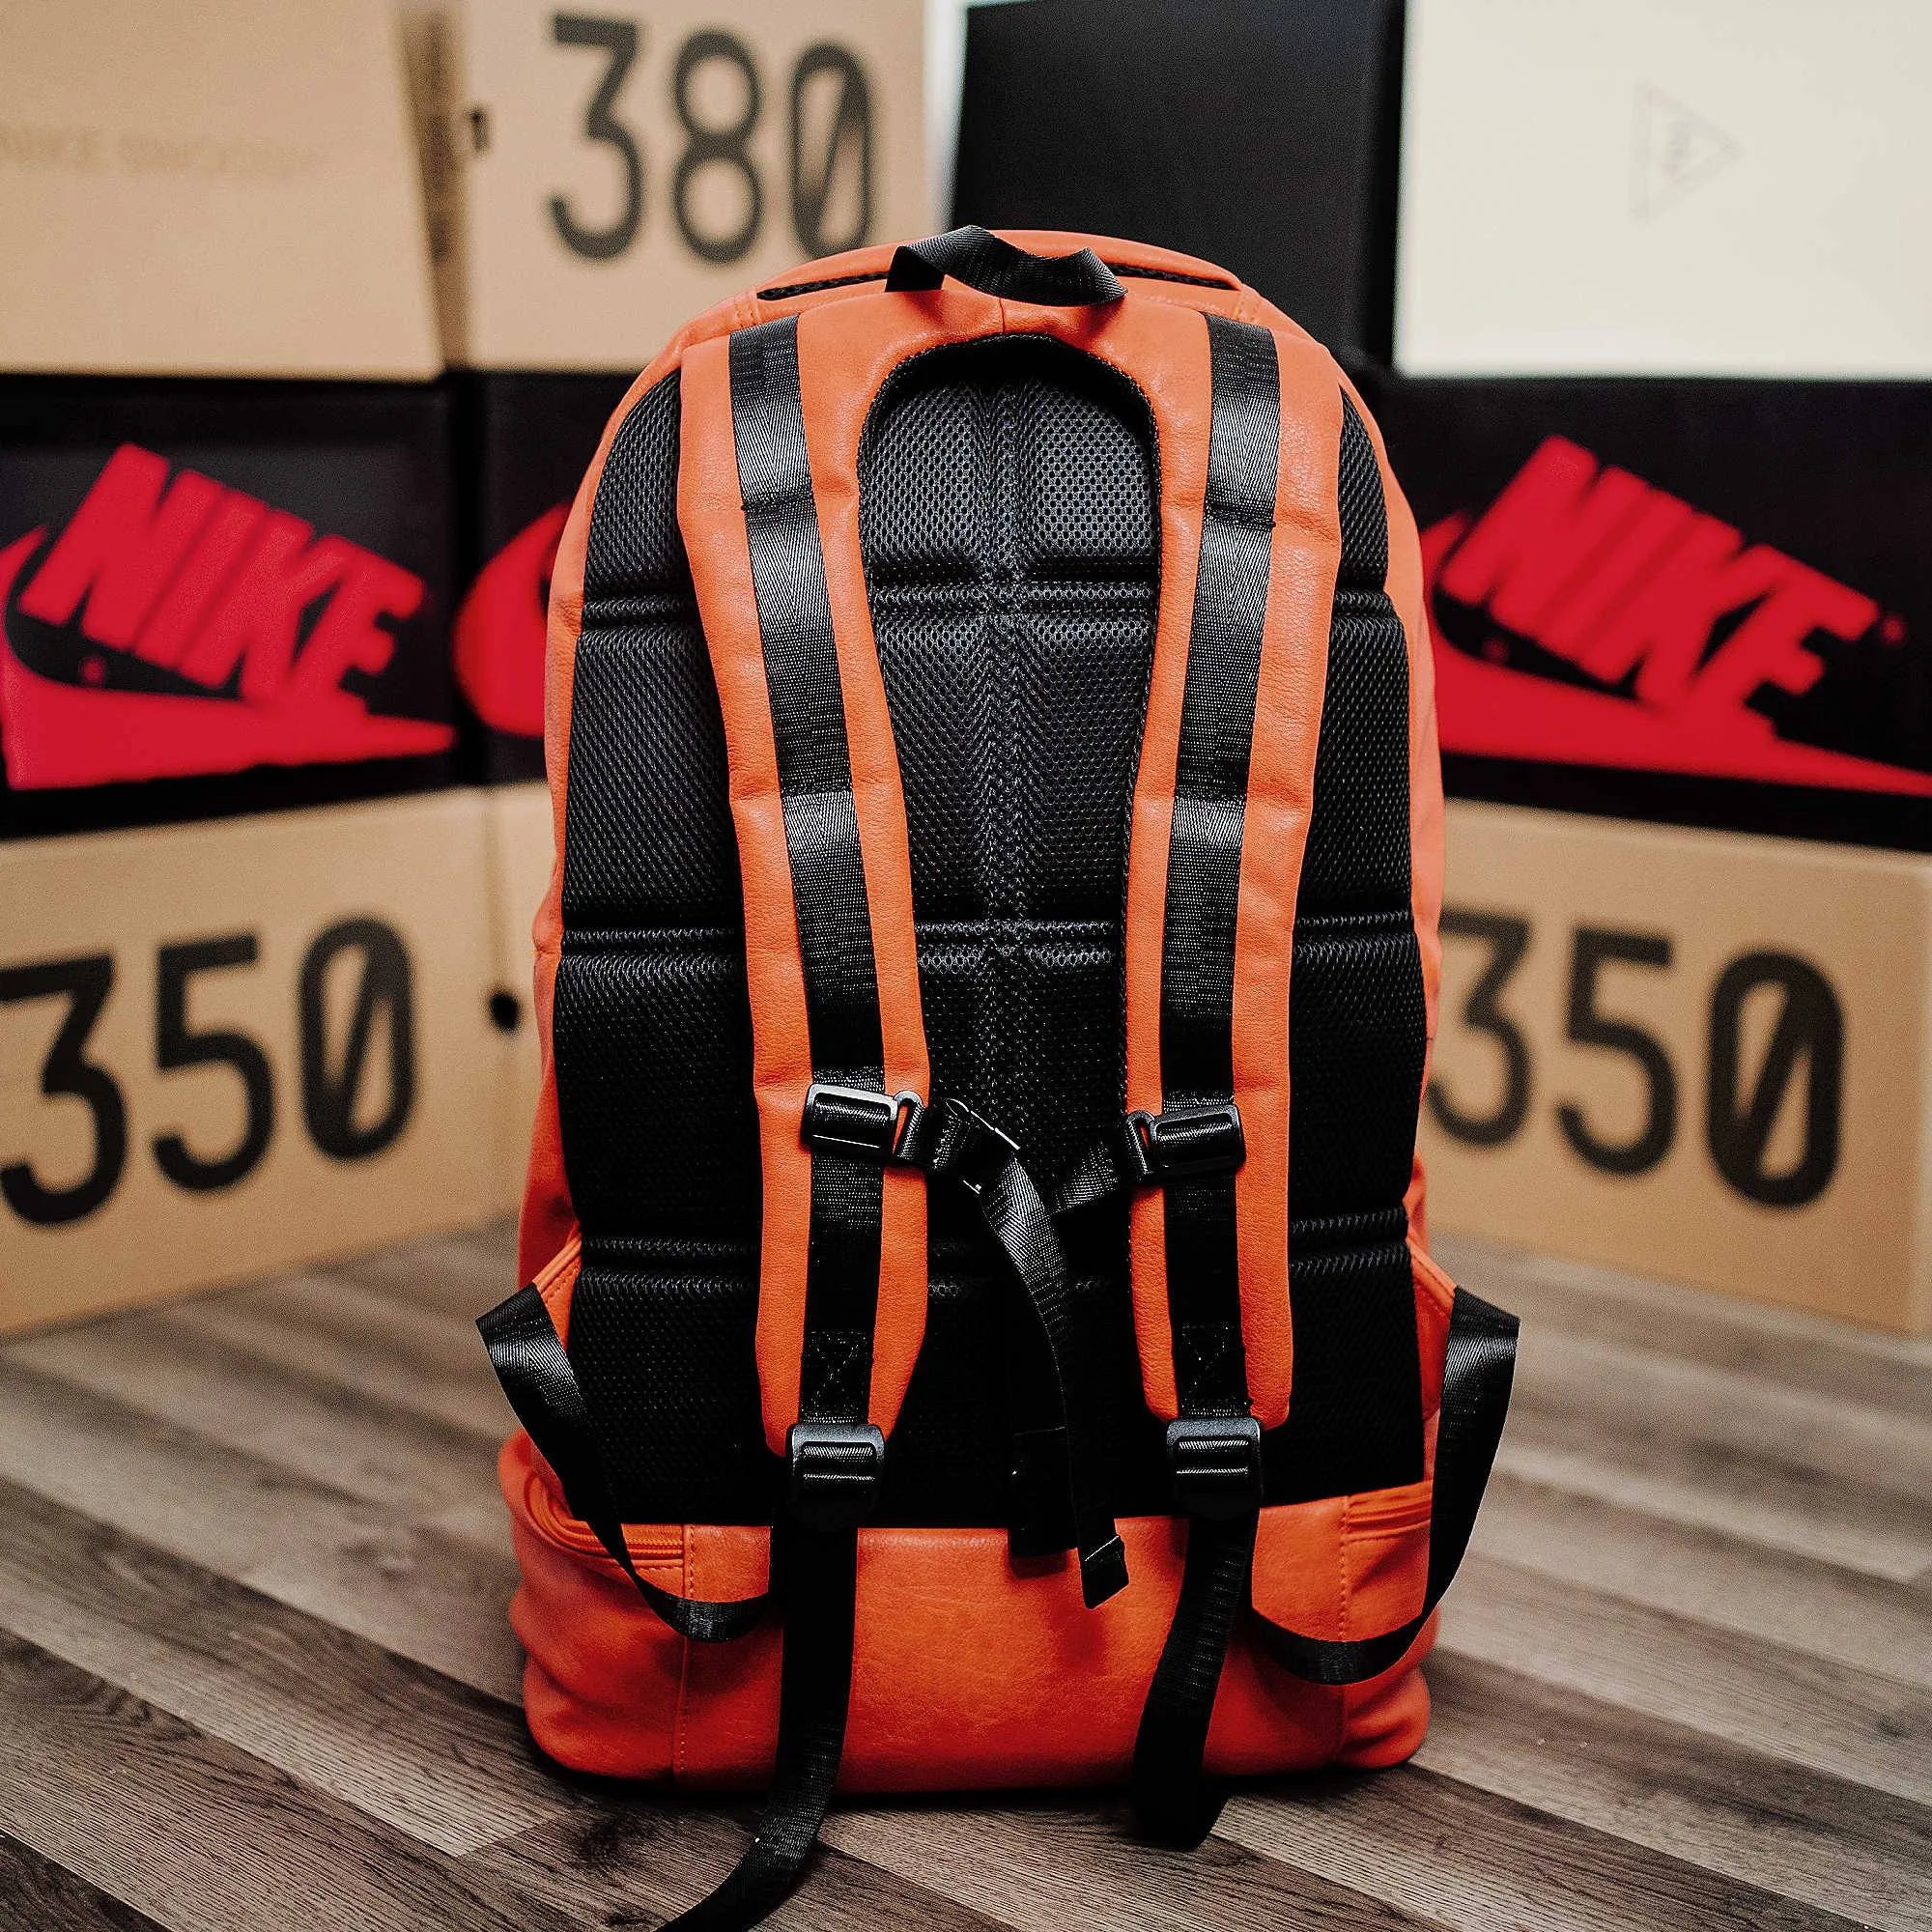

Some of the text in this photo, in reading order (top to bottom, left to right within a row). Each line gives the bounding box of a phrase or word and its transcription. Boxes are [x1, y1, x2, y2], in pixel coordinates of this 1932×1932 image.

[547, 12, 877, 265] 380
[19, 440, 425, 720] NIKE
[1440, 433, 1880, 741] NIKE
[0, 915, 419, 1229] 350
[1424, 904, 1849, 1213] 350
